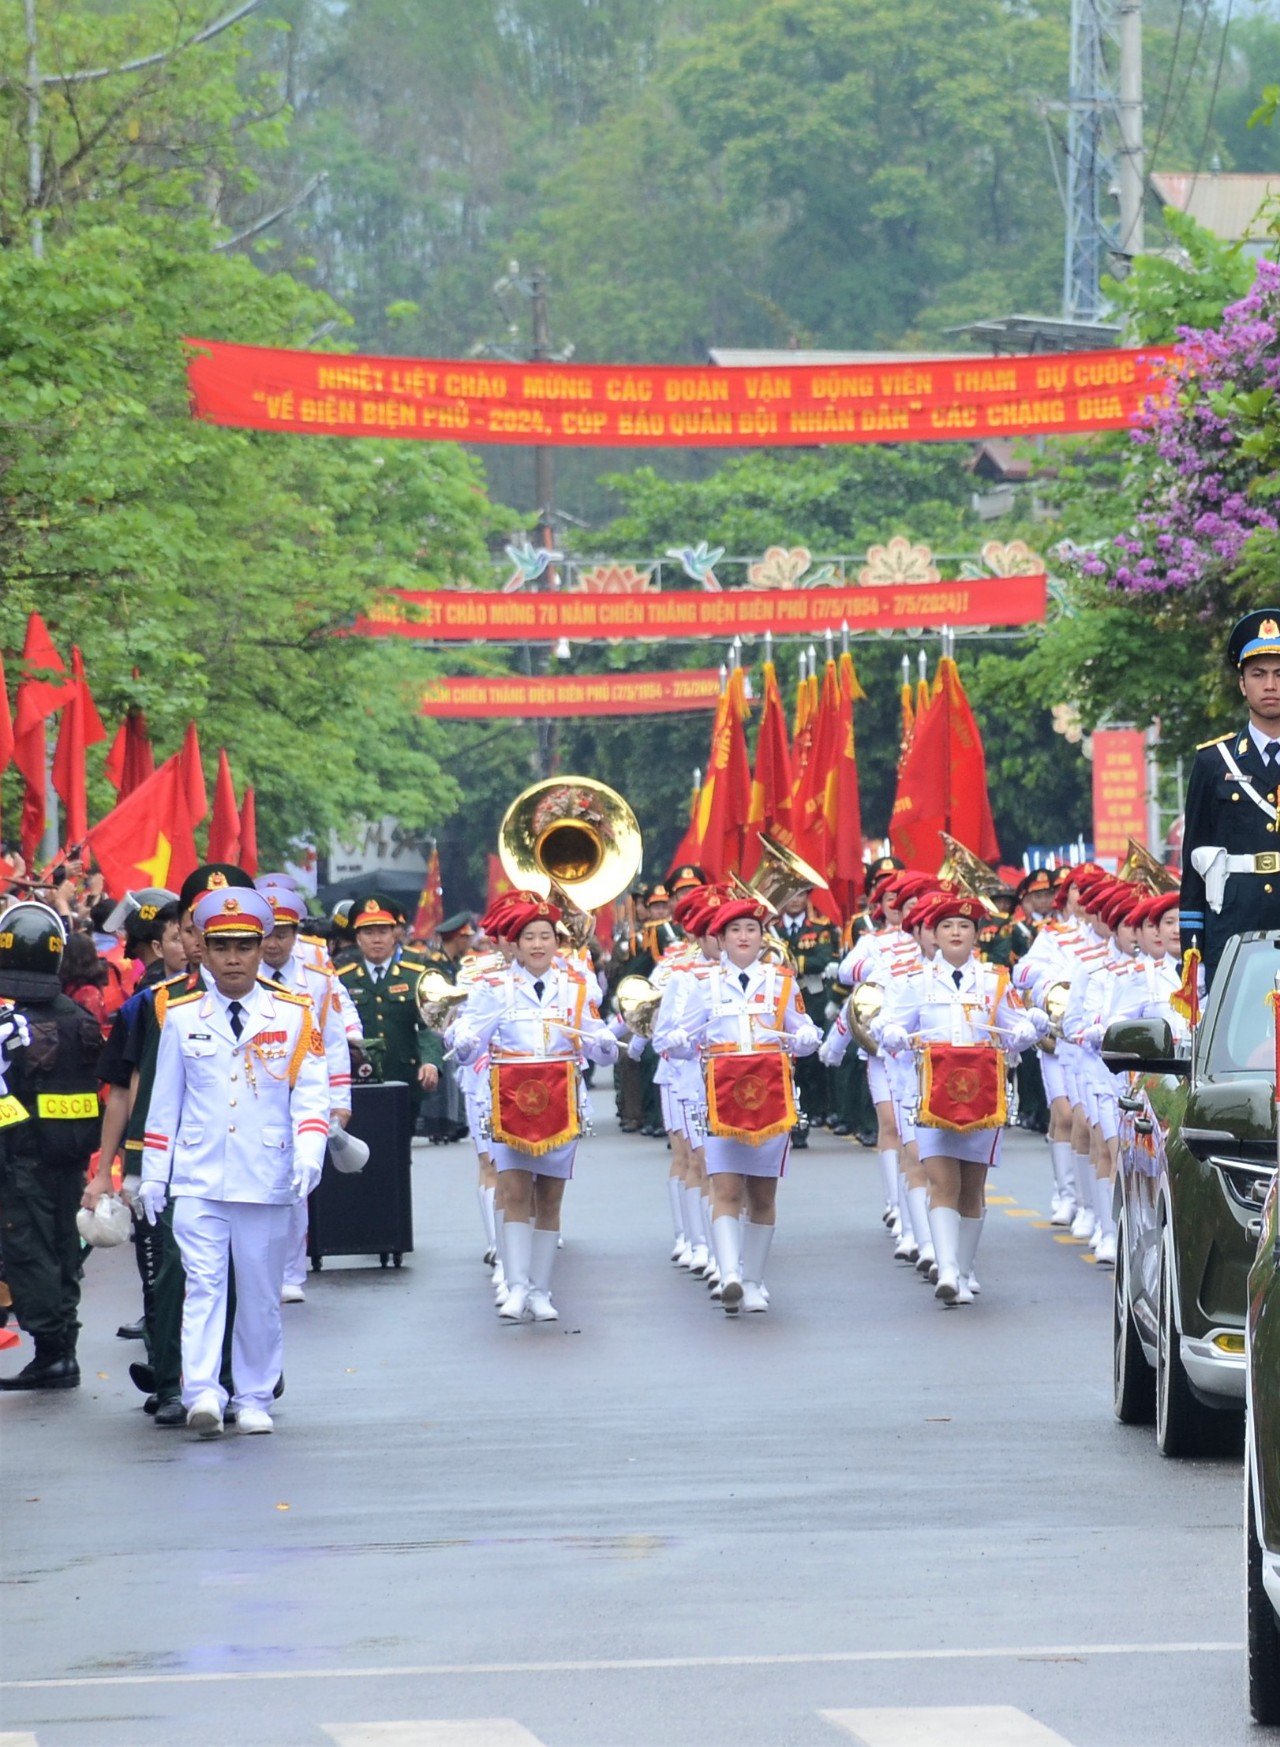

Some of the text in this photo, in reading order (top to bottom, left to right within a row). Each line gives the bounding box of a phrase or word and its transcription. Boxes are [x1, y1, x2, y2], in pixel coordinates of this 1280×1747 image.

[391, 366, 438, 398] LIỆT
[445, 370, 507, 398] CHÀO
[606, 374, 652, 401] CÁC
[745, 372, 791, 402] VẬN
[881, 368, 932, 396] VIÊN
[954, 368, 1017, 392] THAM
[619, 409, 664, 435] BÁO
[670, 407, 732, 436] QUÂN
[790, 404, 855, 432] NHÂN
[931, 401, 976, 428] CÁC
[46, 1099, 92, 1114] CSCĐ
